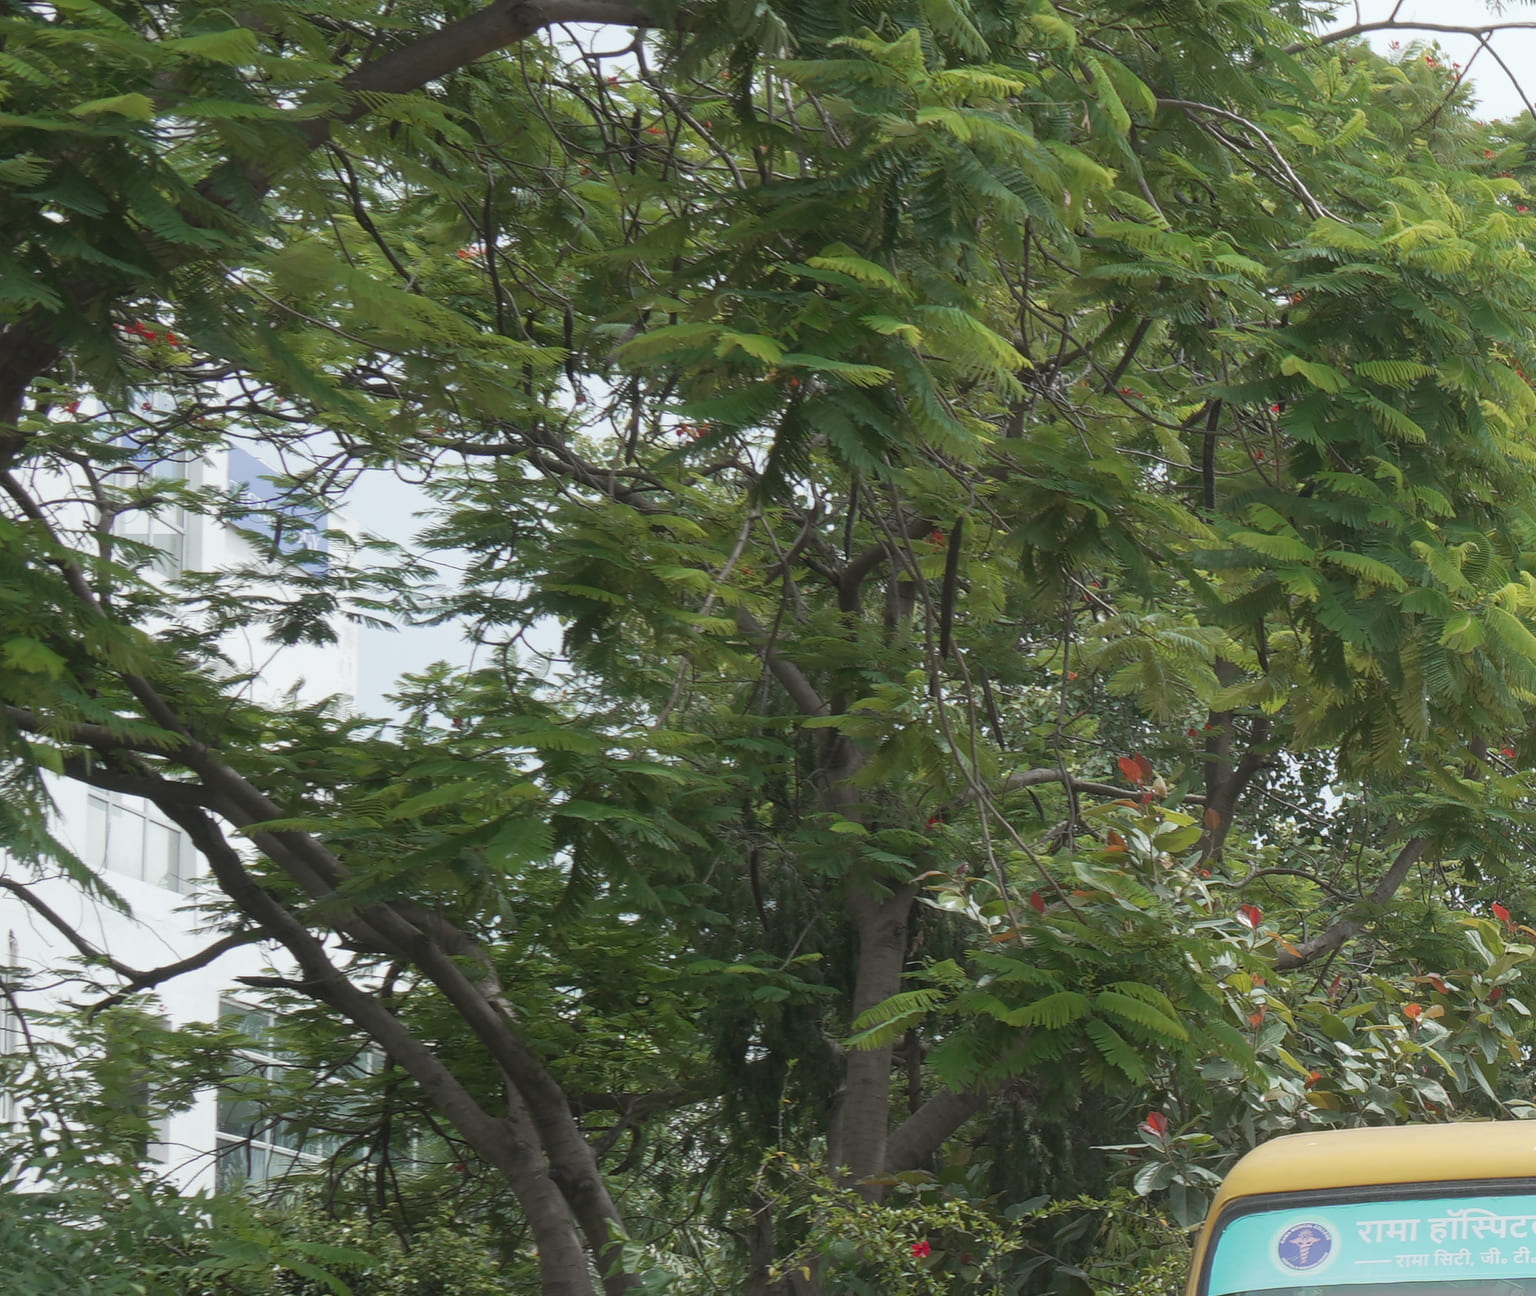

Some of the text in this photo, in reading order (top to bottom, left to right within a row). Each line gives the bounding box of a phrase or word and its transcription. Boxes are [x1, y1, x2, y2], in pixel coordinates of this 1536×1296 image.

[1355, 1218, 1421, 1244] रामा
[1395, 1253, 1430, 1267] रामा
[1433, 1249, 1474, 1268] सिटी,
